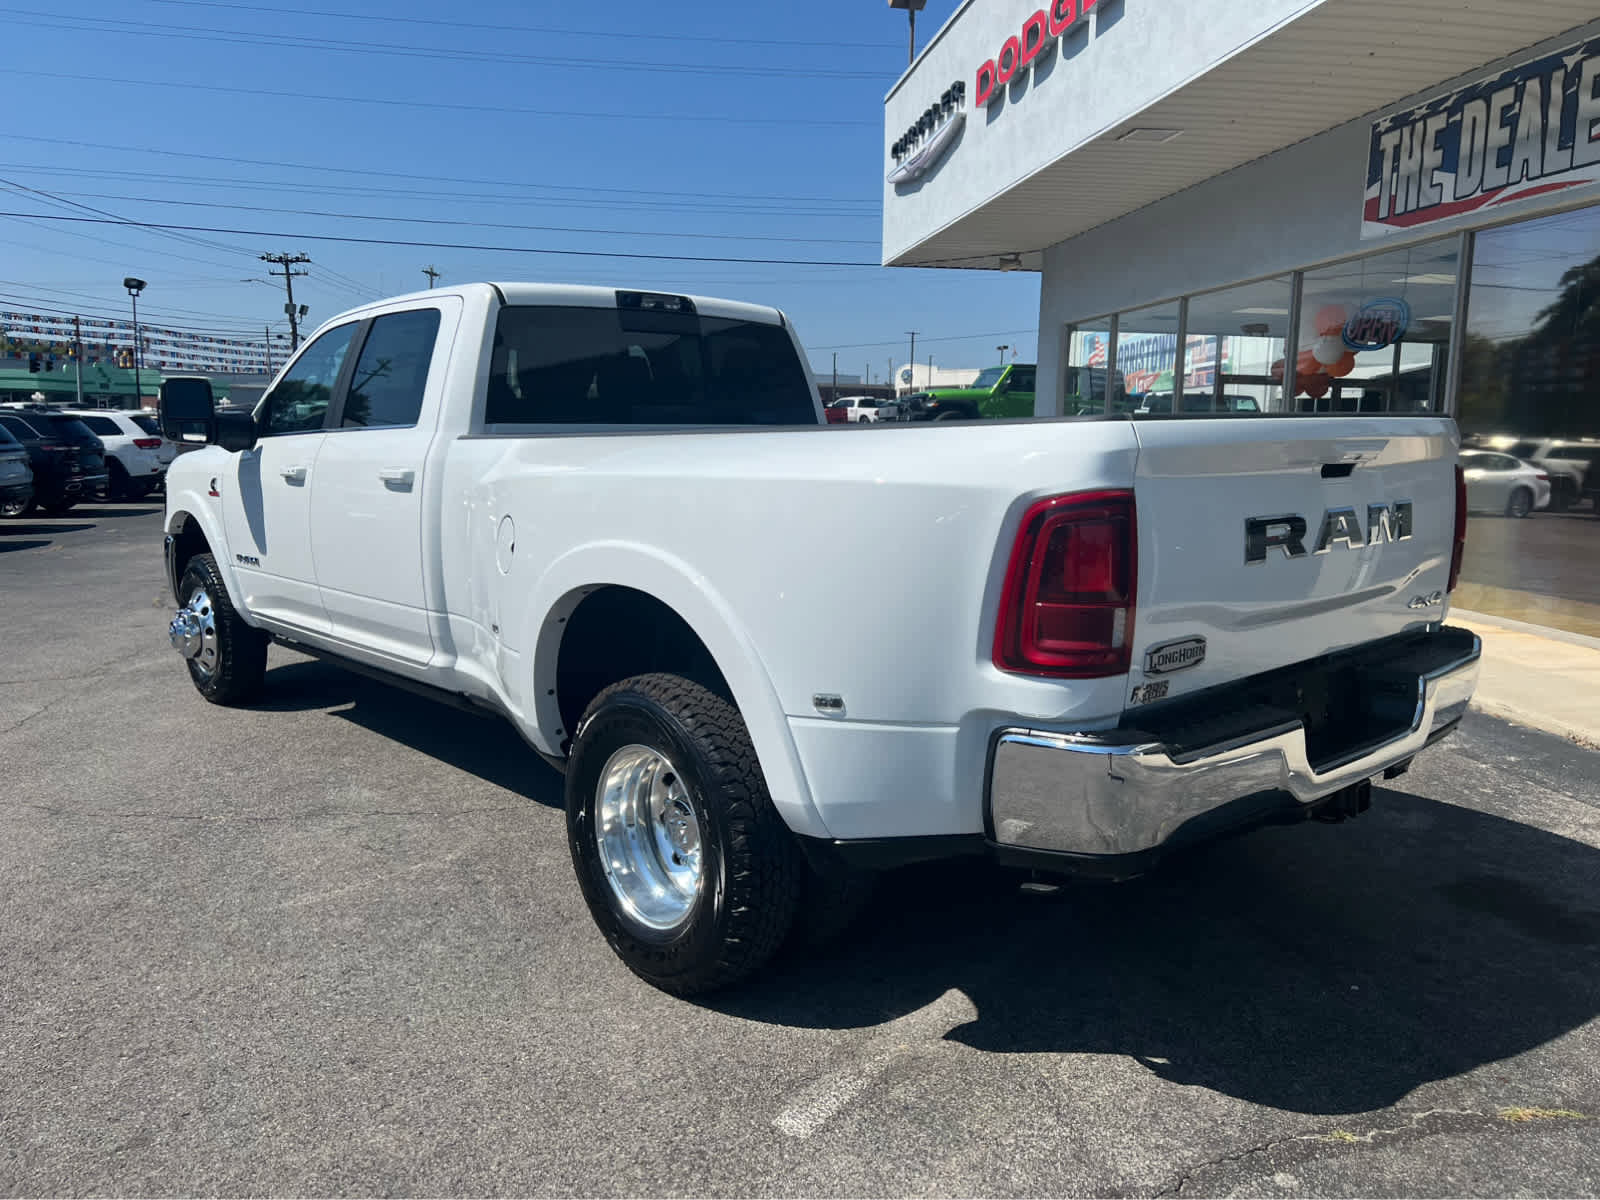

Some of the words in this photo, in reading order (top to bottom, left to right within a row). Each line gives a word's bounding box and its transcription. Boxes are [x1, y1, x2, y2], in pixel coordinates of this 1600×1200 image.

[975, 0, 1096, 108] DODG
[1378, 112, 1449, 220] THE
[1117, 334, 1177, 376] ORRISTOWN
[1244, 498, 1413, 567] RAM
[1149, 645, 1206, 670] LONGHORN
